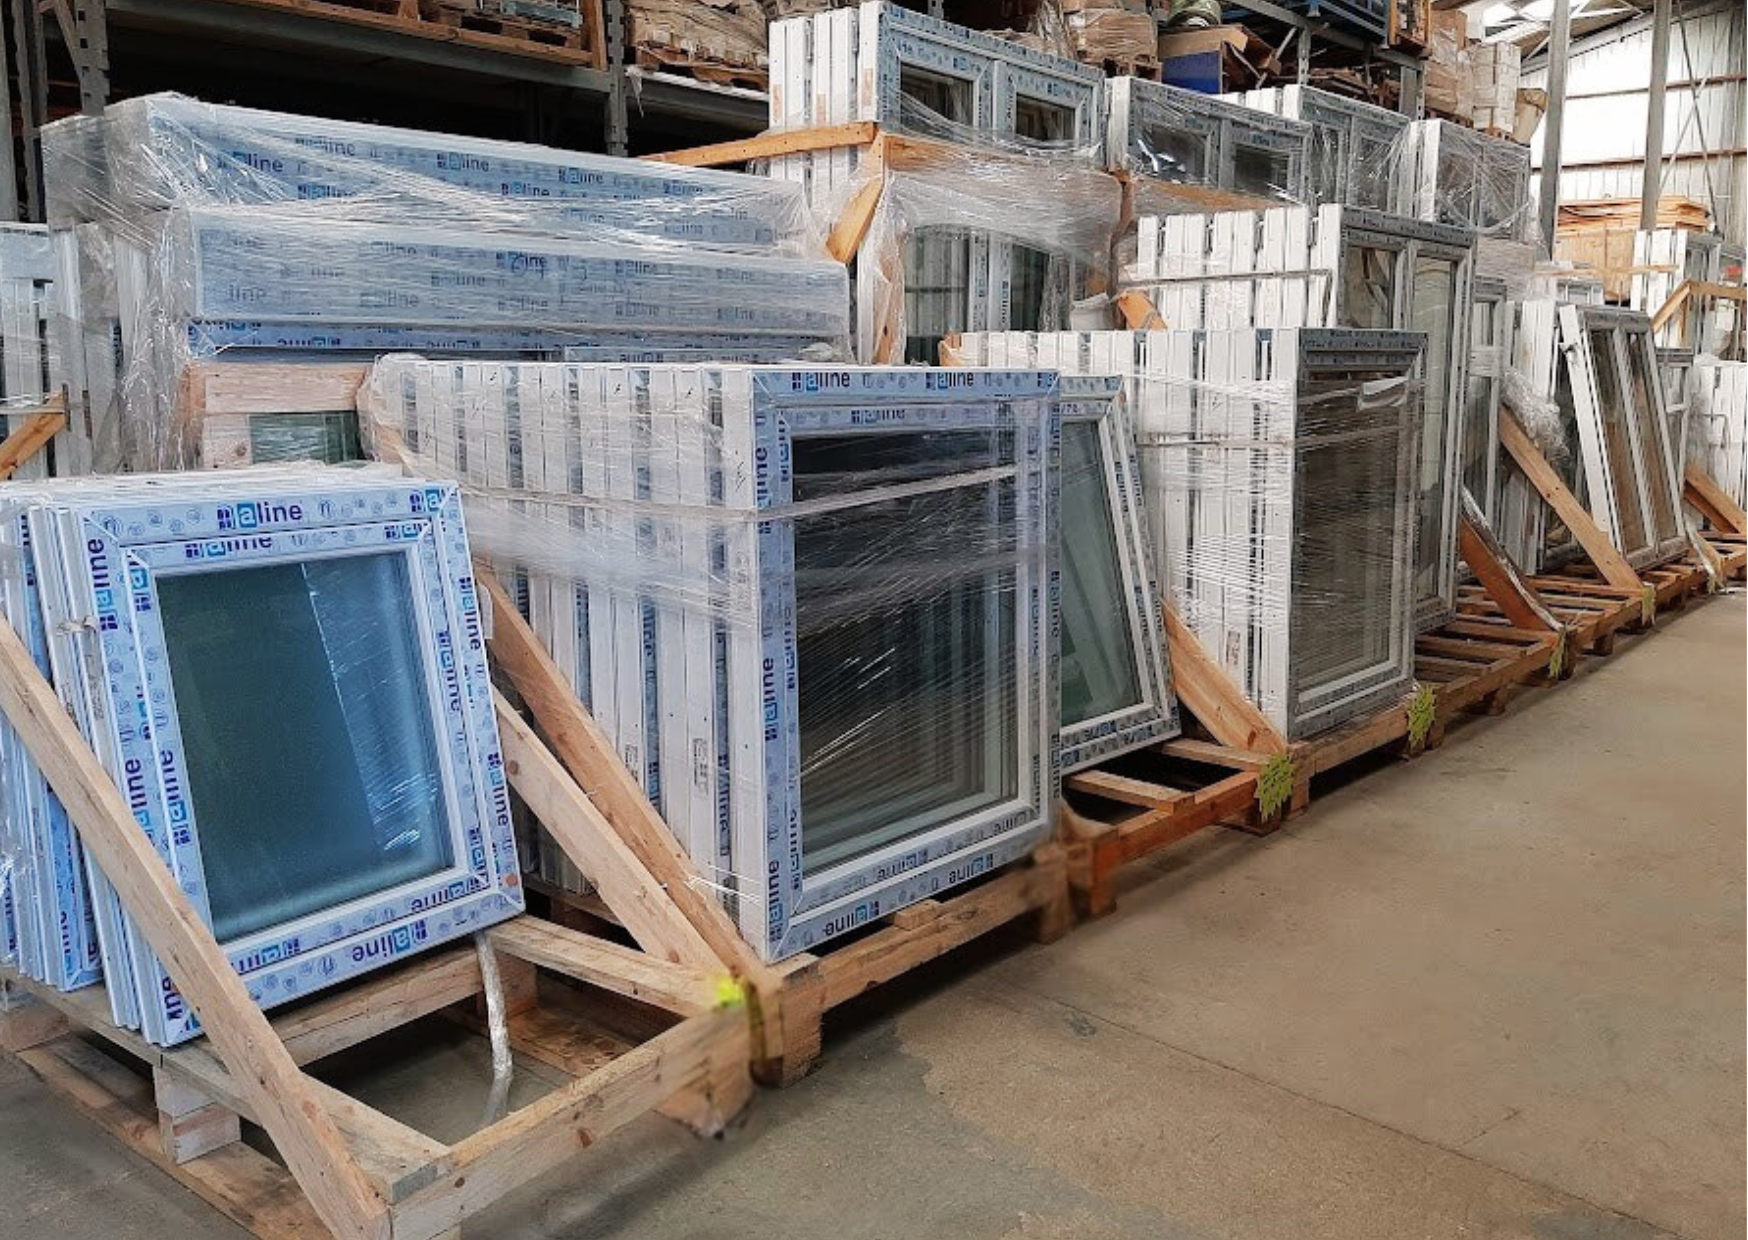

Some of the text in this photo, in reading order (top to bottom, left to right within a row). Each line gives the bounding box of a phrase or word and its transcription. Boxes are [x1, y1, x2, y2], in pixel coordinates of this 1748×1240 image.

[806, 371, 850, 391] aline
[937, 371, 974, 390] aline
[236, 501, 302, 529] aline
[87, 538, 115, 609] aline
[462, 596, 482, 651] aline
[763, 657, 779, 723] aline
[490, 773, 510, 827] aline
[948, 856, 985, 884] aline
[768, 860, 784, 923] aline
[824, 901, 869, 937] aline
[352, 925, 412, 963] aline
